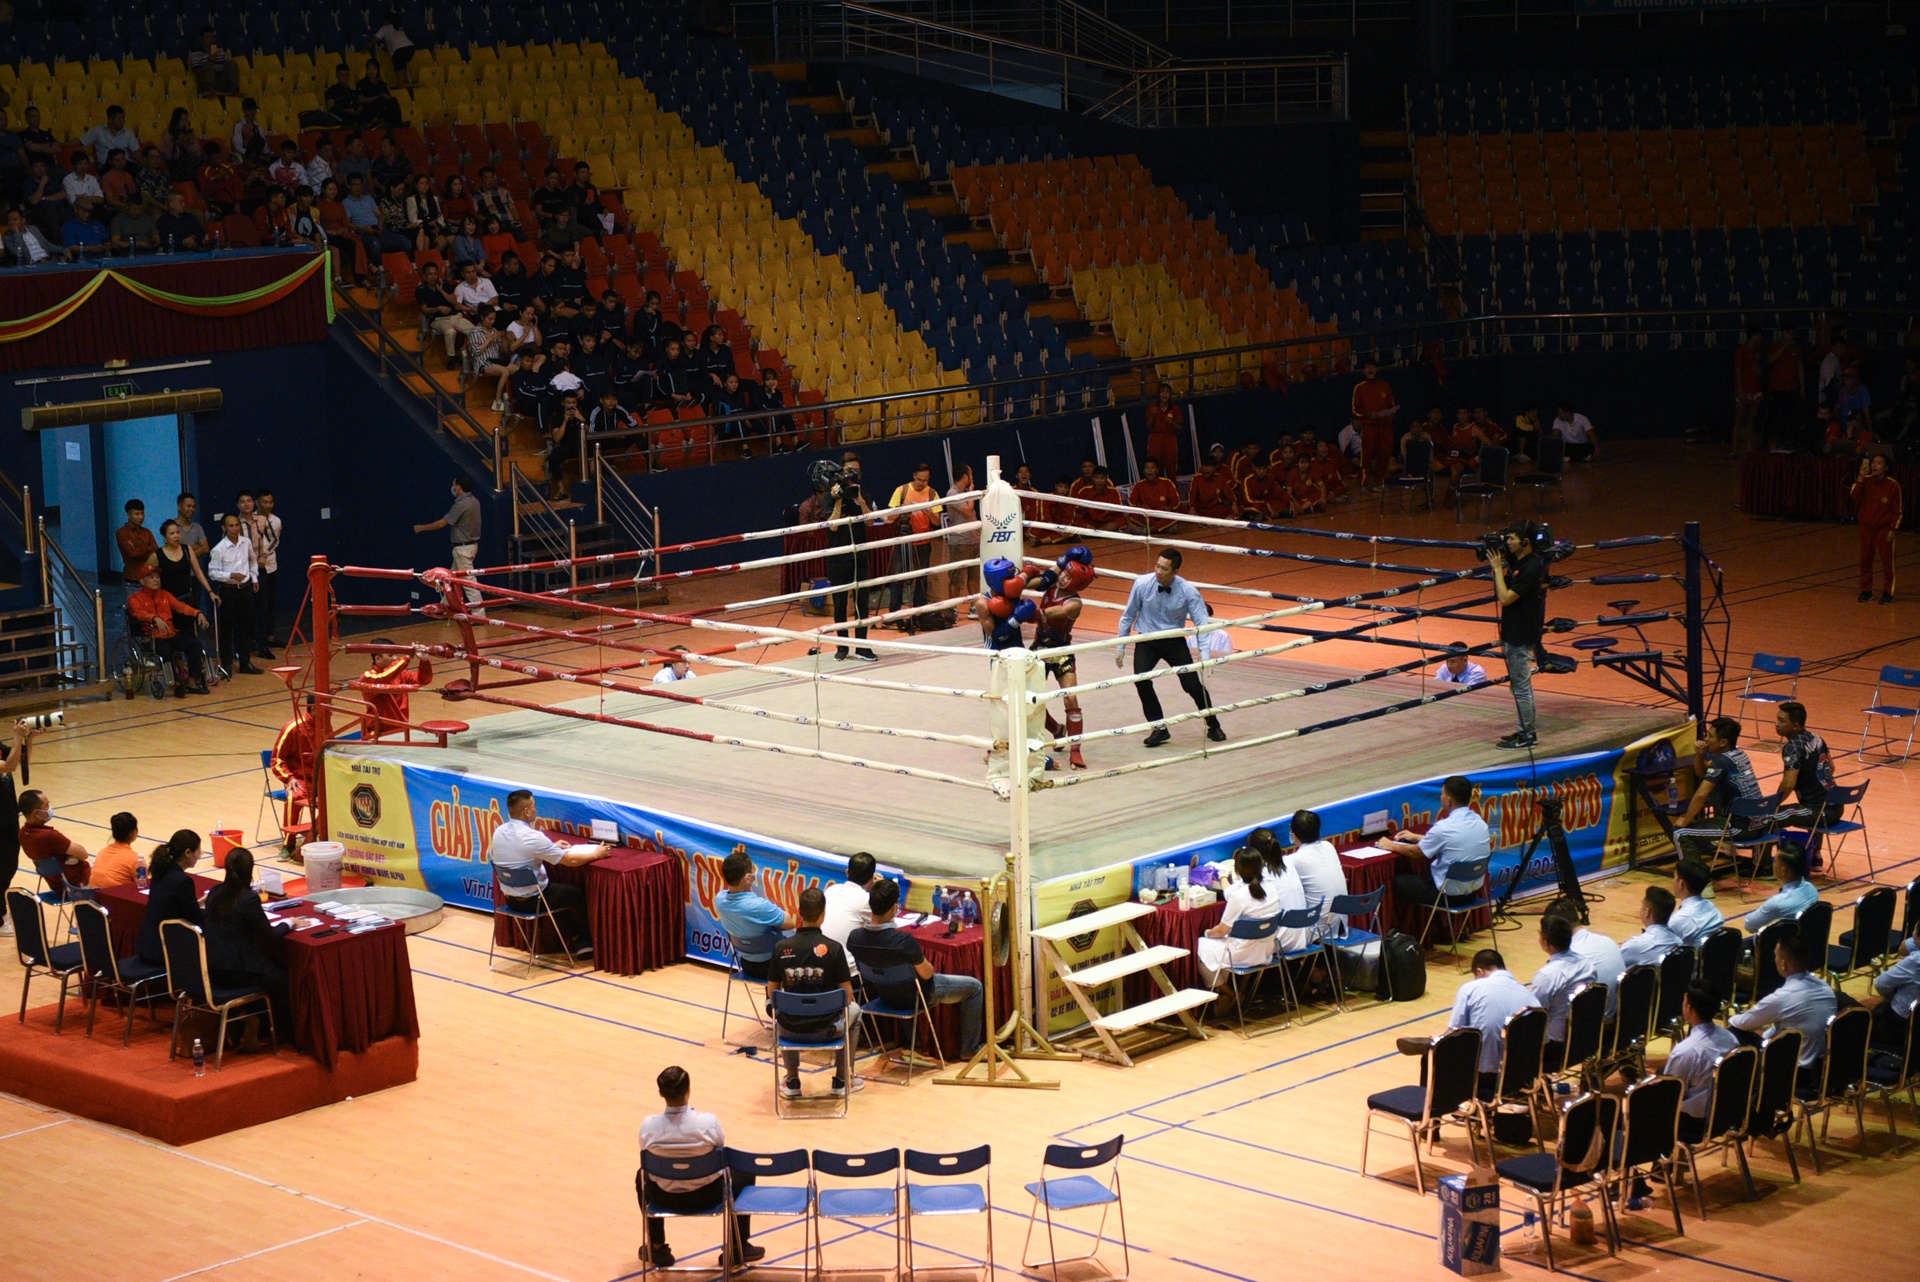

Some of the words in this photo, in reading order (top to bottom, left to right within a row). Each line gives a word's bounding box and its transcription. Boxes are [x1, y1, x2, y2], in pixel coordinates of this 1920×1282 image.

[107, 385, 130, 397] EXIT
[987, 531, 1016, 543] FBT
[430, 784, 474, 862] GIẢI
[361, 866, 376, 876] HONDA
[376, 868, 390, 879] WAVE
[390, 870, 406, 881] ALPHA
[1069, 880, 1081, 892] NHÀ
[1083, 878, 1092, 889] TÀI
[1093, 875, 1106, 887] TRỢ
[691, 926, 732, 959] ngày
[1058, 1004, 1065, 1015] XE
[1096, 990, 1110, 1002] WAVE
[1447, 1216, 1455, 1265] AQUAFINA
